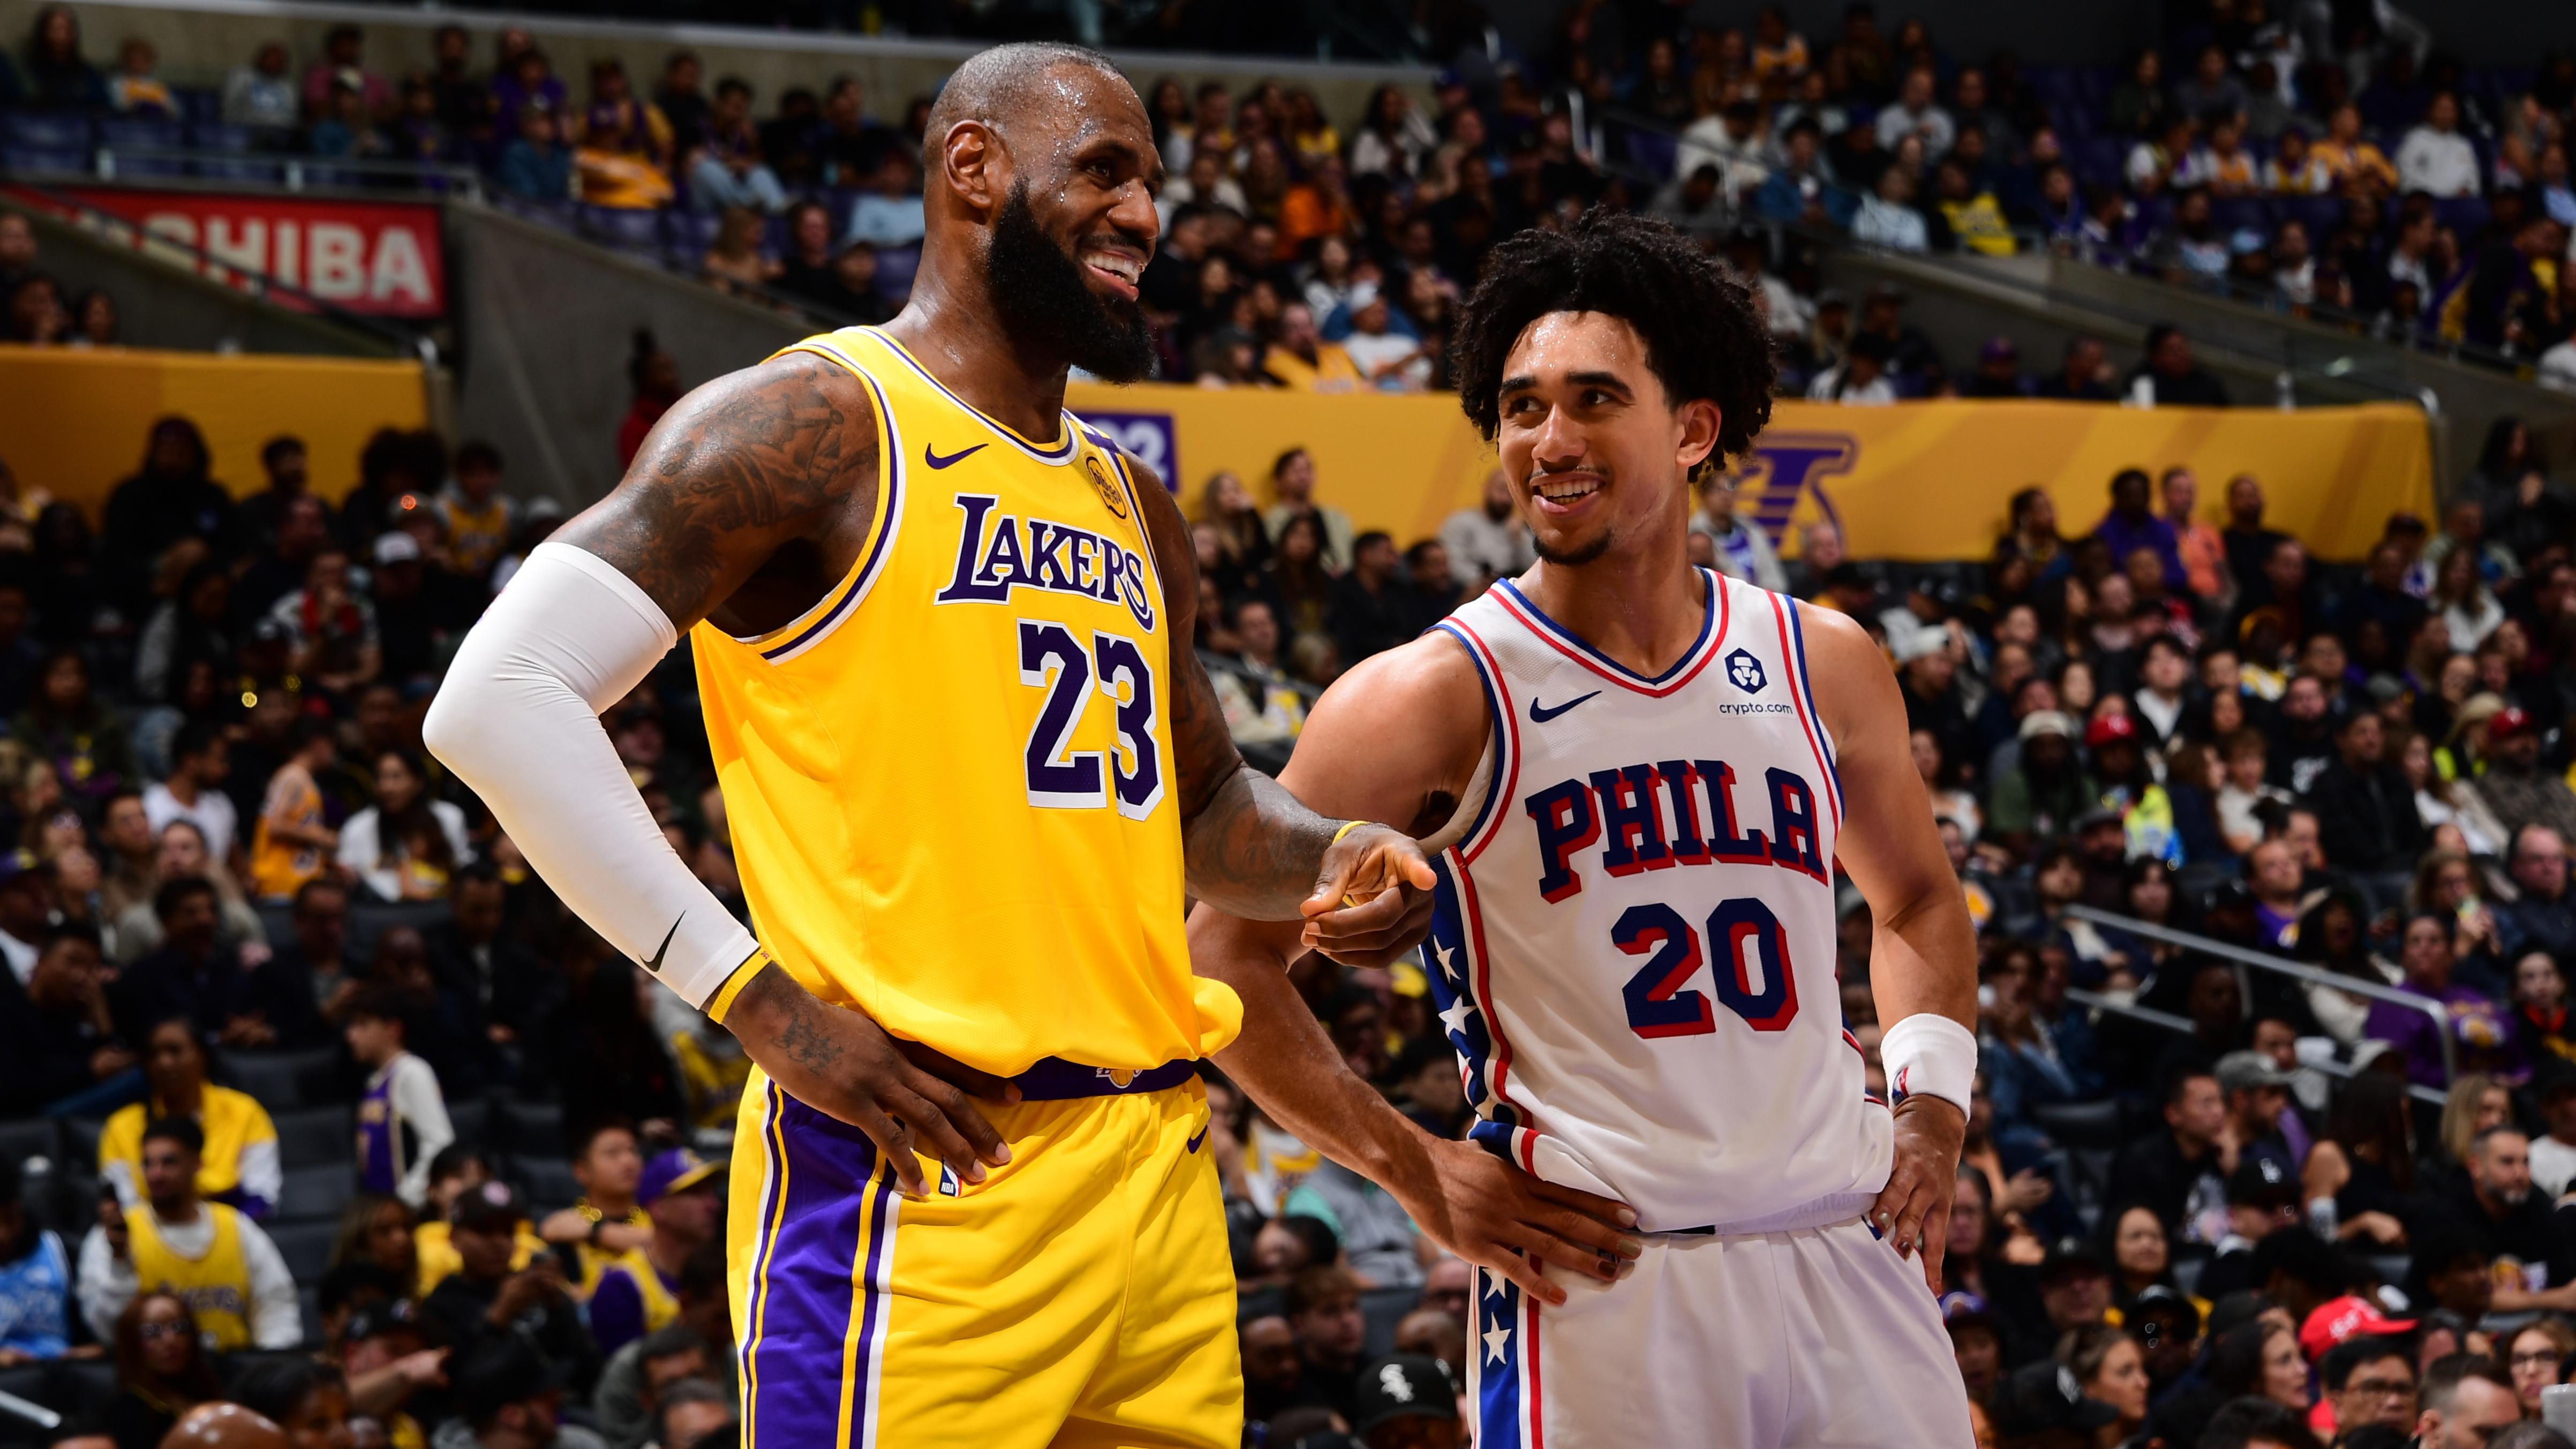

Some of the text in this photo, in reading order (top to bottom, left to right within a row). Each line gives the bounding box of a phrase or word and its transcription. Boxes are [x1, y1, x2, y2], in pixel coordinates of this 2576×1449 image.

[47, 205, 432, 303] SHIBA
[933, 492, 1155, 635] LAKERS
[1016, 617, 1165, 822] 23
[1719, 702, 1793, 715] crypto.com
[1524, 759, 1829, 904] PHILA
[1610, 897, 1799, 1039] 20
[940, 1182, 954, 1194] NBA
